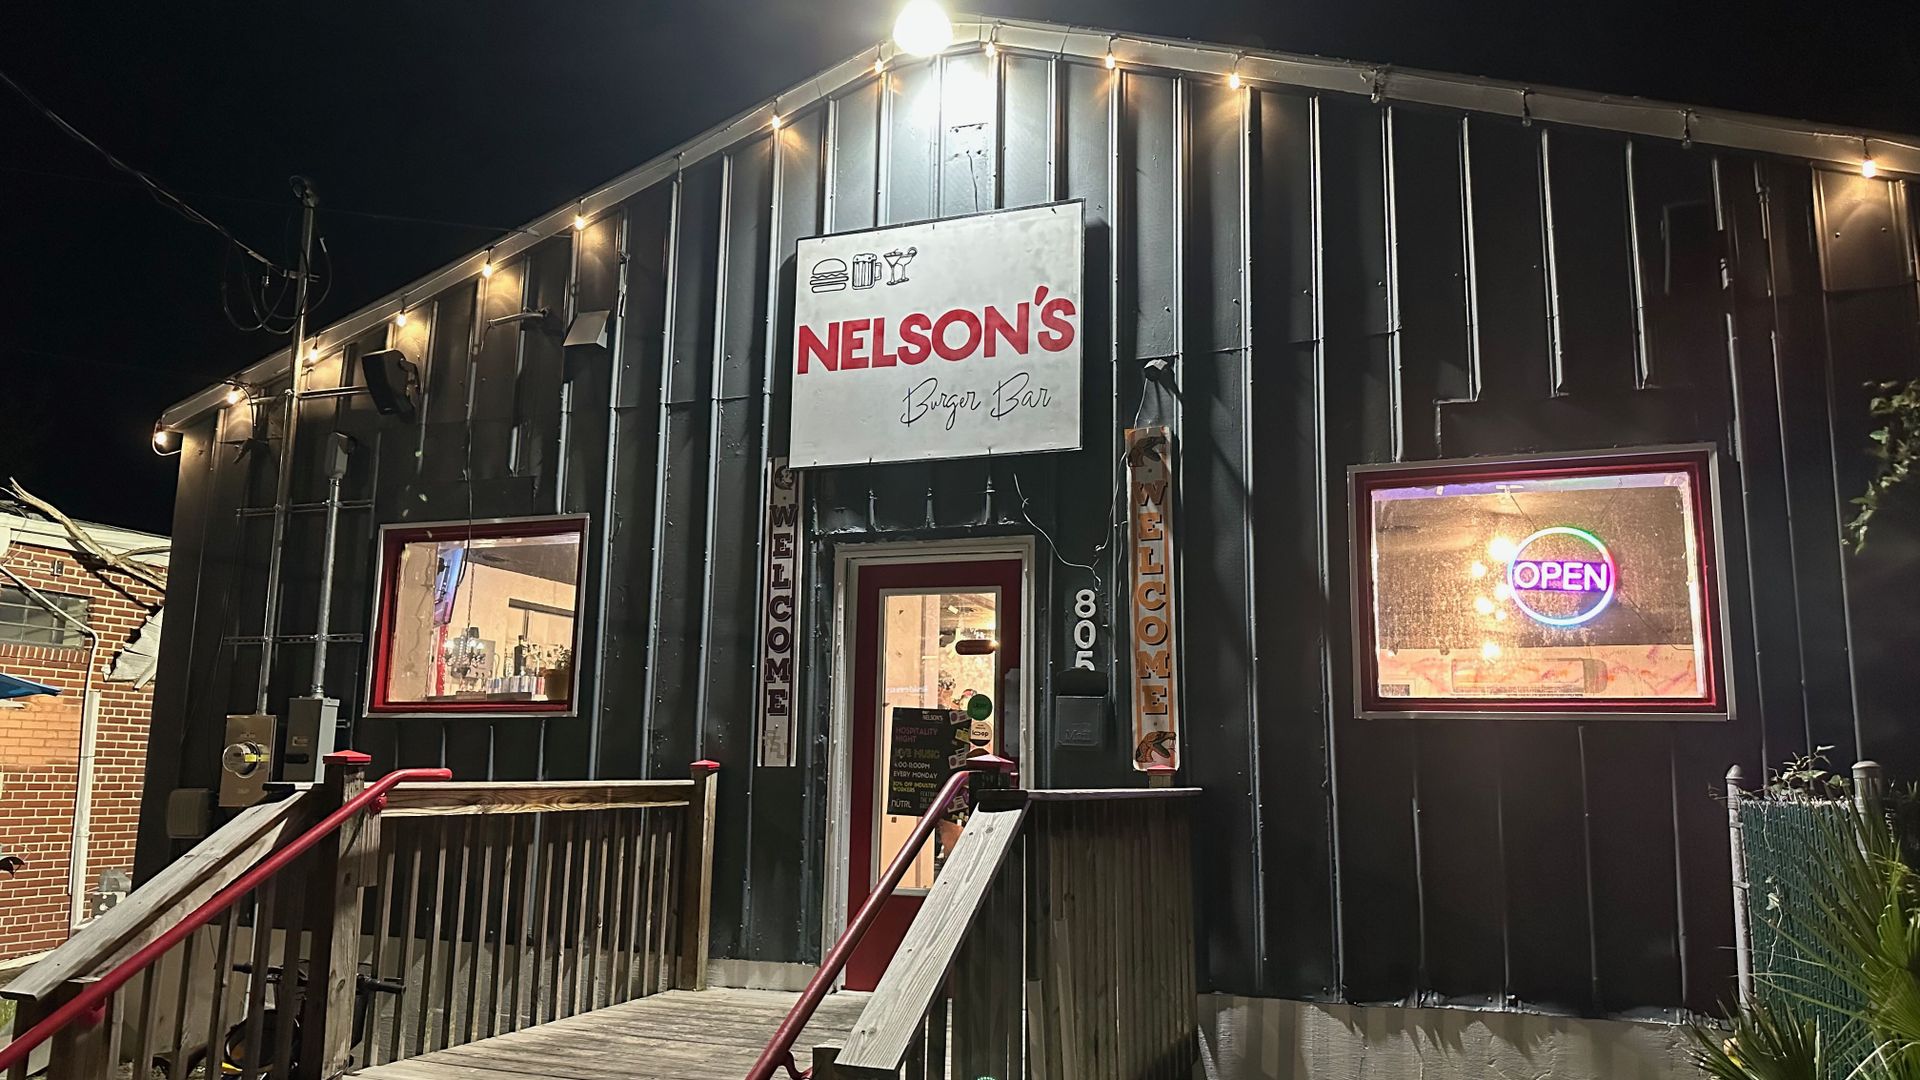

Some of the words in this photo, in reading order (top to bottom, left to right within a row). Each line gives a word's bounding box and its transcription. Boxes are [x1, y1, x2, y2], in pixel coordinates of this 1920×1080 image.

[797, 285, 1077, 375] NELSON'S
[899, 377, 982, 431] Burger
[990, 372, 1052, 421] Bar
[764, 503, 799, 717] WELCOME
[1130, 480, 1171, 715] WELCOME
[1514, 562, 1608, 592] OPEN
[895, 726, 938, 736] HOSPITALITY
